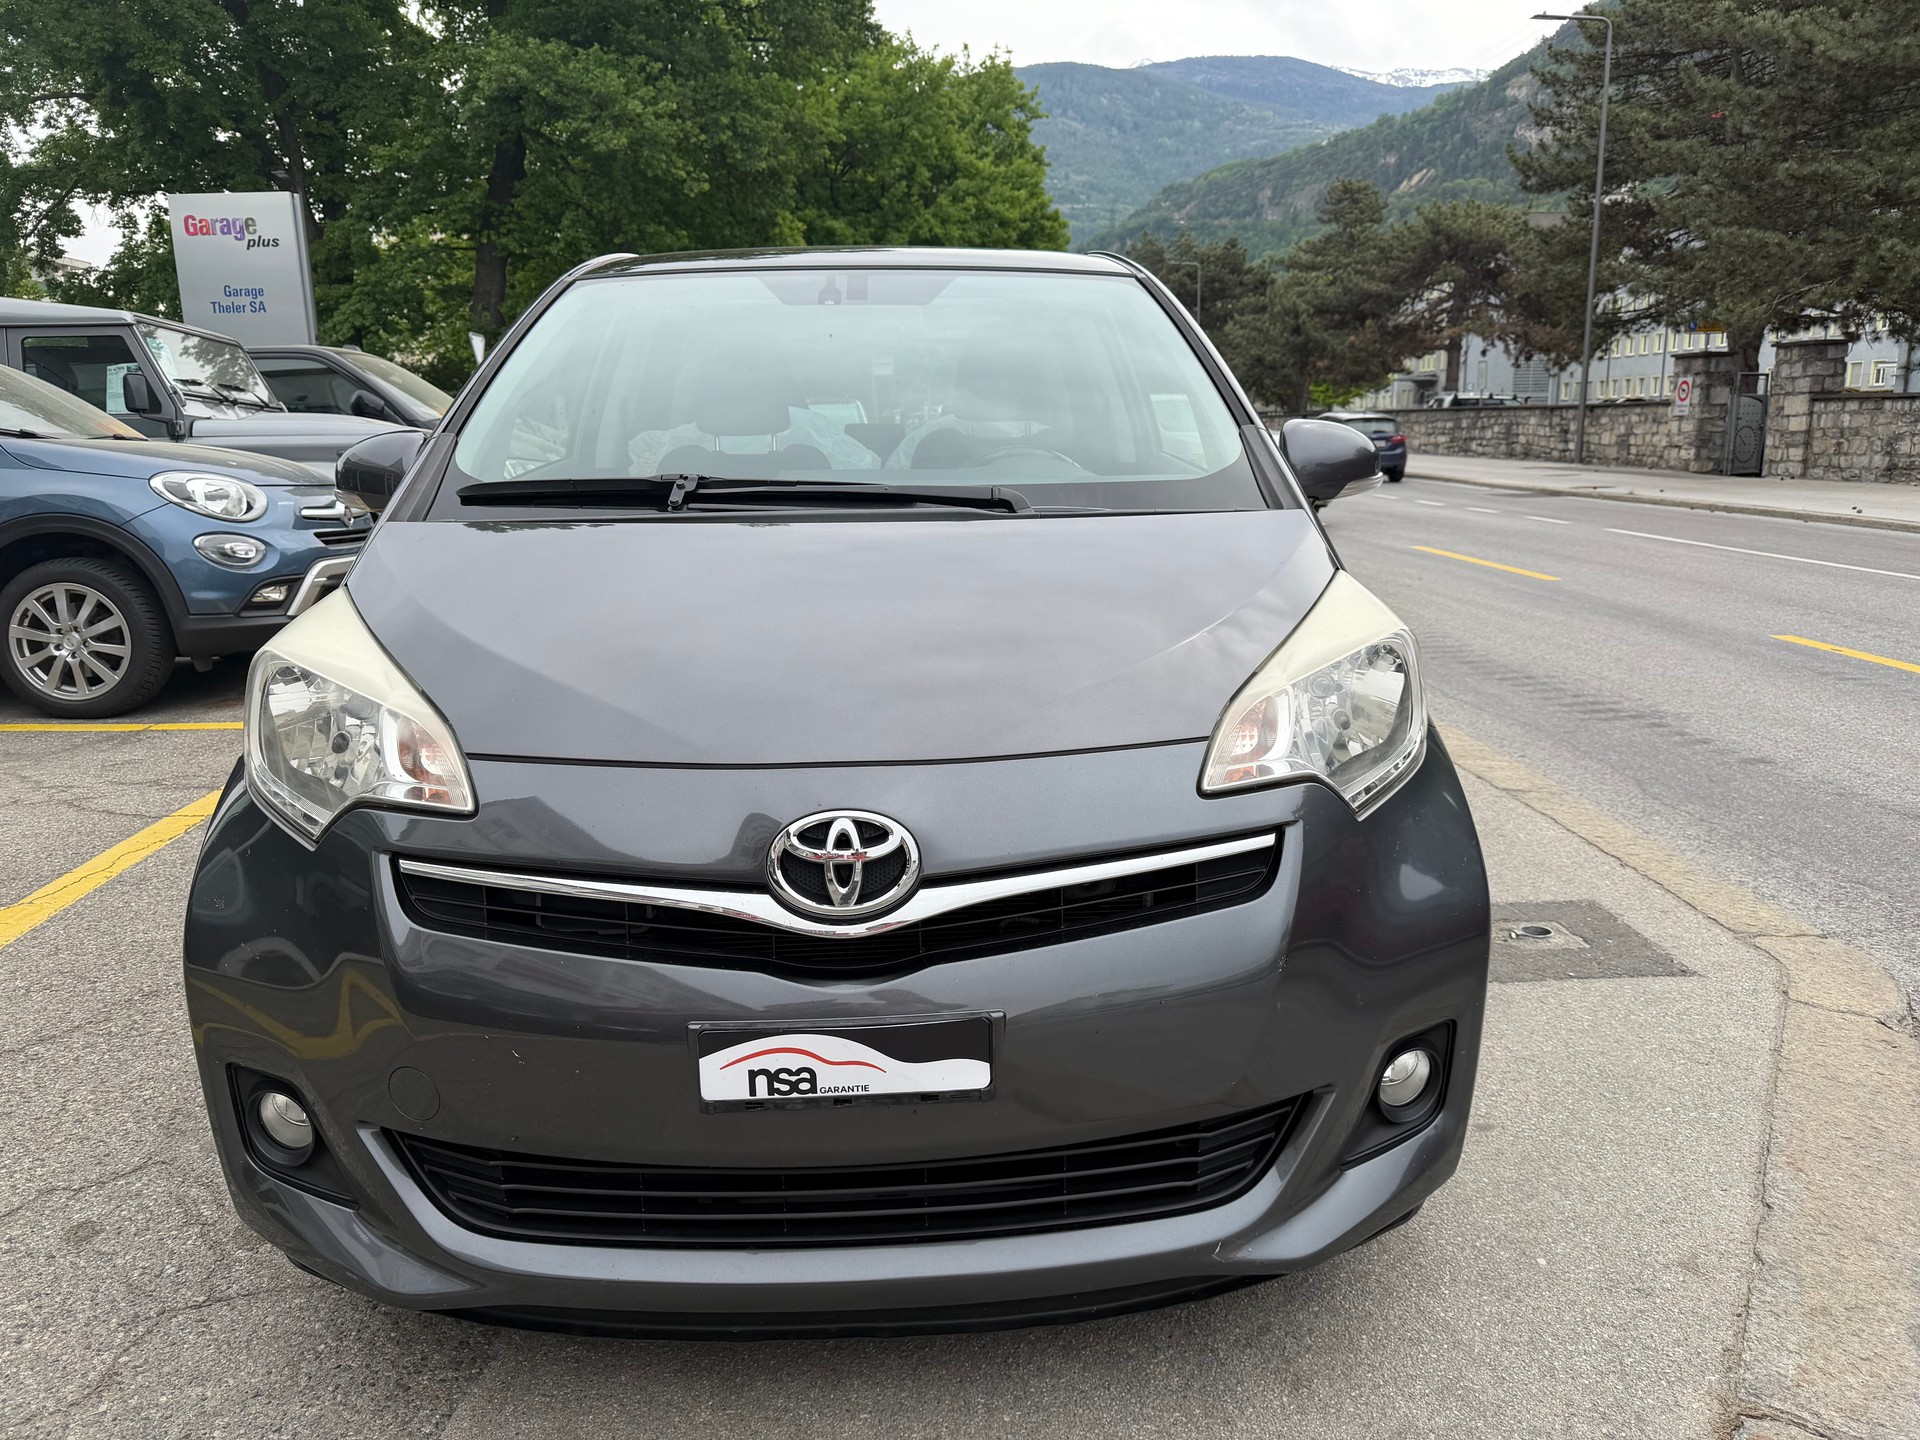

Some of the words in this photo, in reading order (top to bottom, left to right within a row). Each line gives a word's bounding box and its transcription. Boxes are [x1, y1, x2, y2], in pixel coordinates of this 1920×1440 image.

[183, 215, 257, 241] Garage
[246, 235, 280, 250] plus
[223, 285, 264, 299] Garage
[210, 301, 247, 314] Theler
[249, 301, 267, 313] SA
[748, 1067, 818, 1097] nsa
[819, 1085, 870, 1094] GARANTIE
